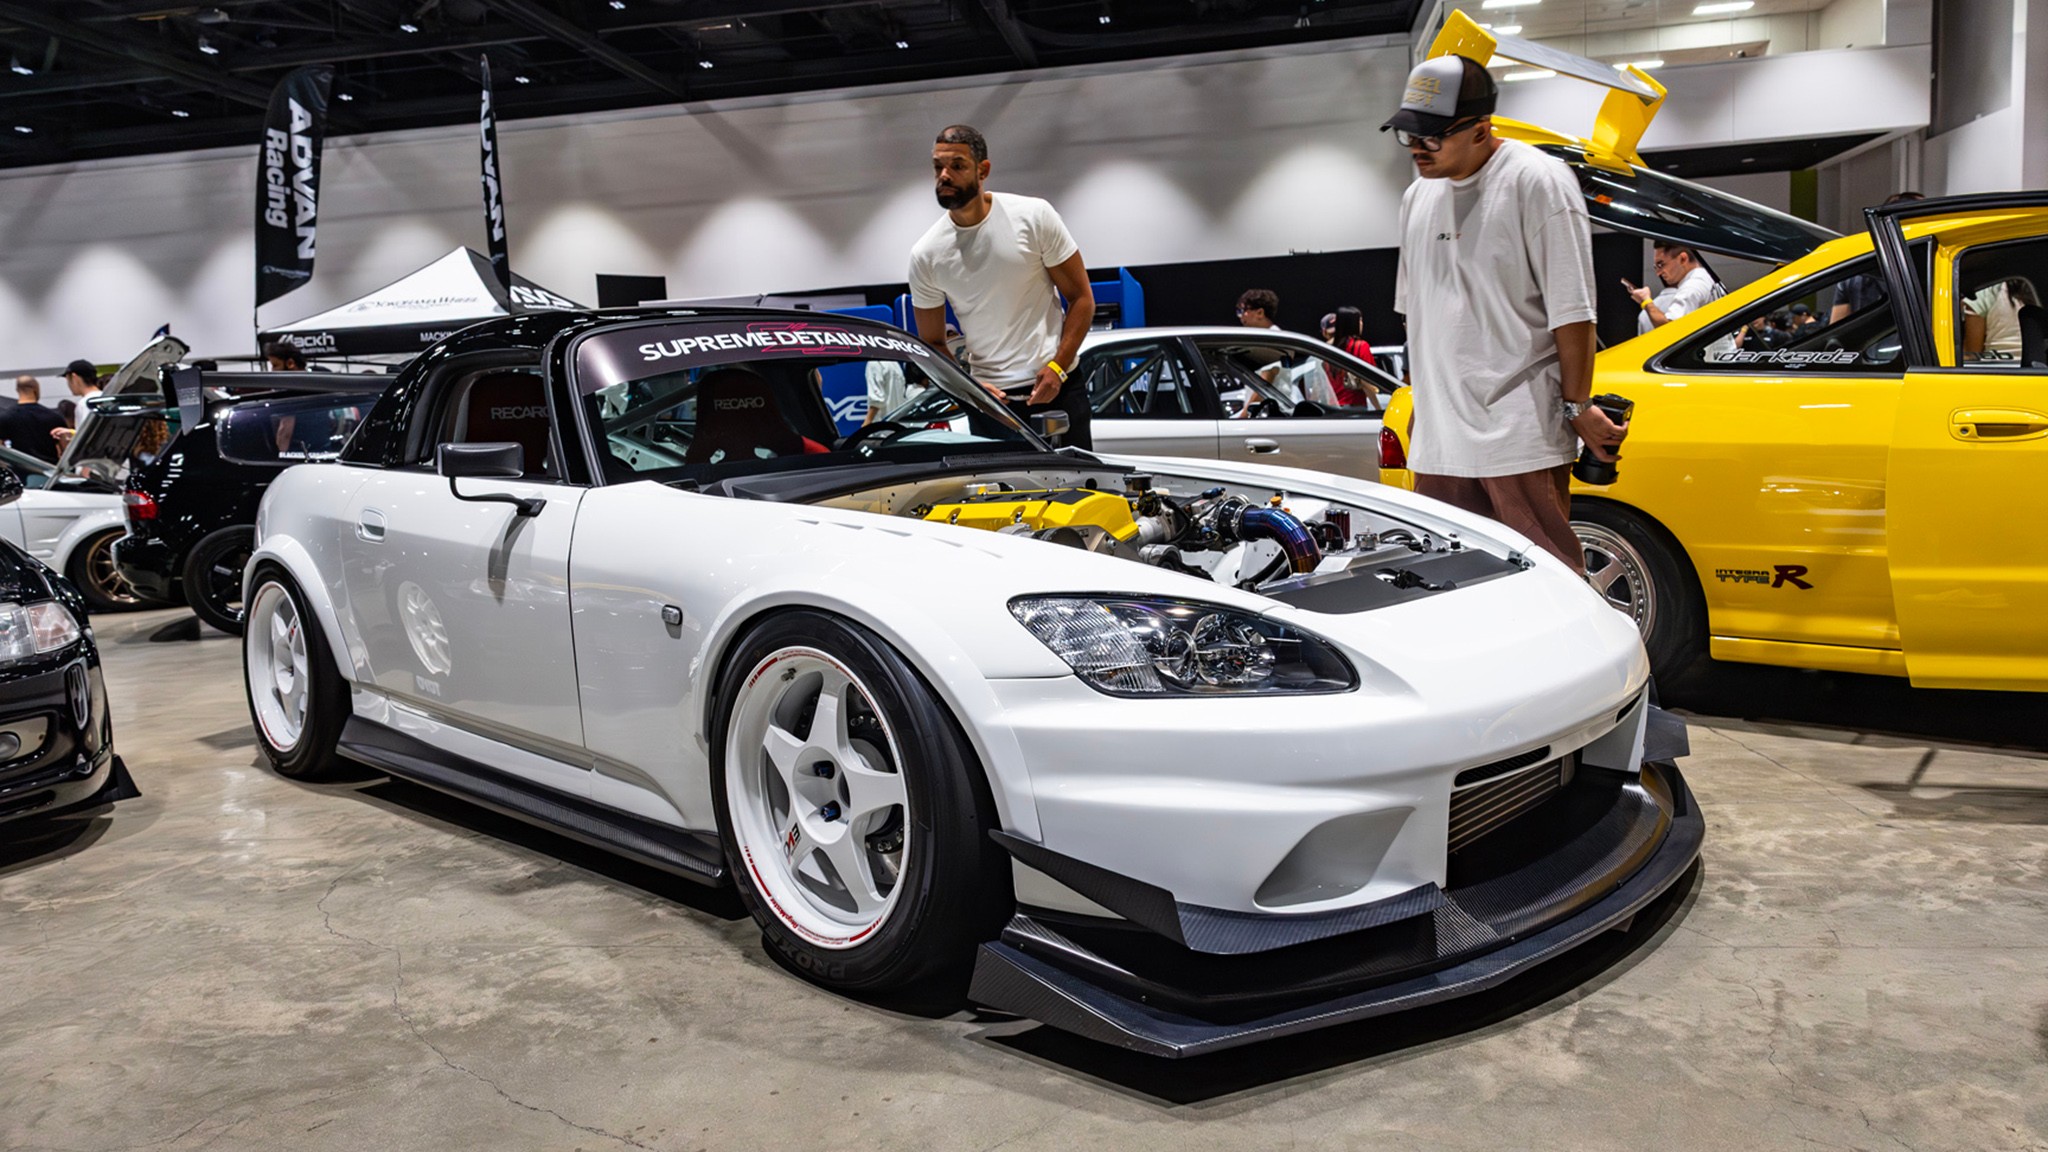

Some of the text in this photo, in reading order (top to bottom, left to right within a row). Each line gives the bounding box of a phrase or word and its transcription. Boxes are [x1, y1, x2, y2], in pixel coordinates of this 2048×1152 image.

[265, 128, 291, 229] Racing
[289, 97, 317, 259] ADVAN
[1719, 348, 1859, 363] darkside
[714, 397, 765, 410] RECARO
[1715, 565, 1814, 590] TYPE R
